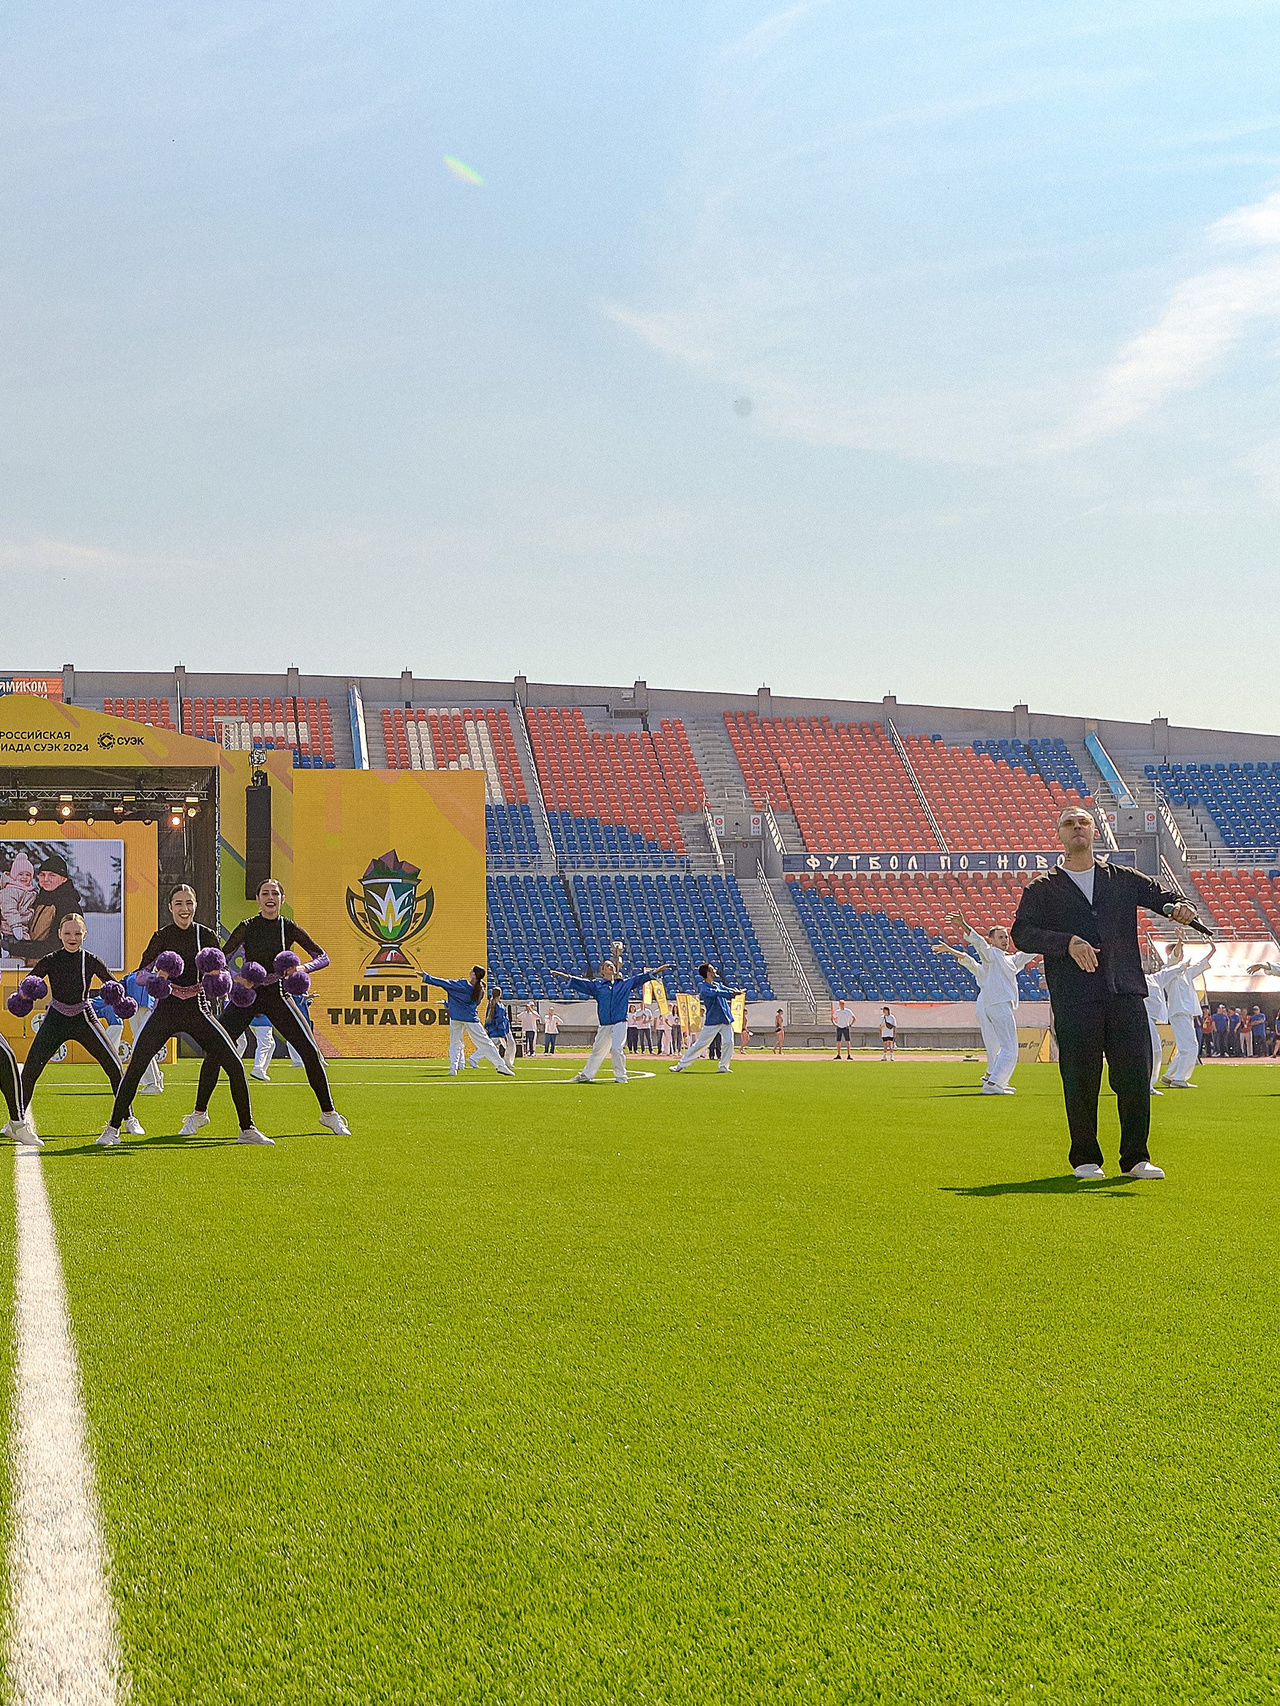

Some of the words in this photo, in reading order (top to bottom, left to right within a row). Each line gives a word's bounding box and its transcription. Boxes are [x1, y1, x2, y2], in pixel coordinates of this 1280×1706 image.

[33, 743, 61, 752] СУЭК
[63, 743, 89, 752] 2024
[116, 736, 145, 746] СУЭК
[805, 854, 919, 871] ФУТБОЛ
[939, 853, 1110, 870] ПО-НОВОУ
[353, 985, 429, 1002] ИГРЫ
[327, 1008, 450, 1026] ТИТАНОВ
